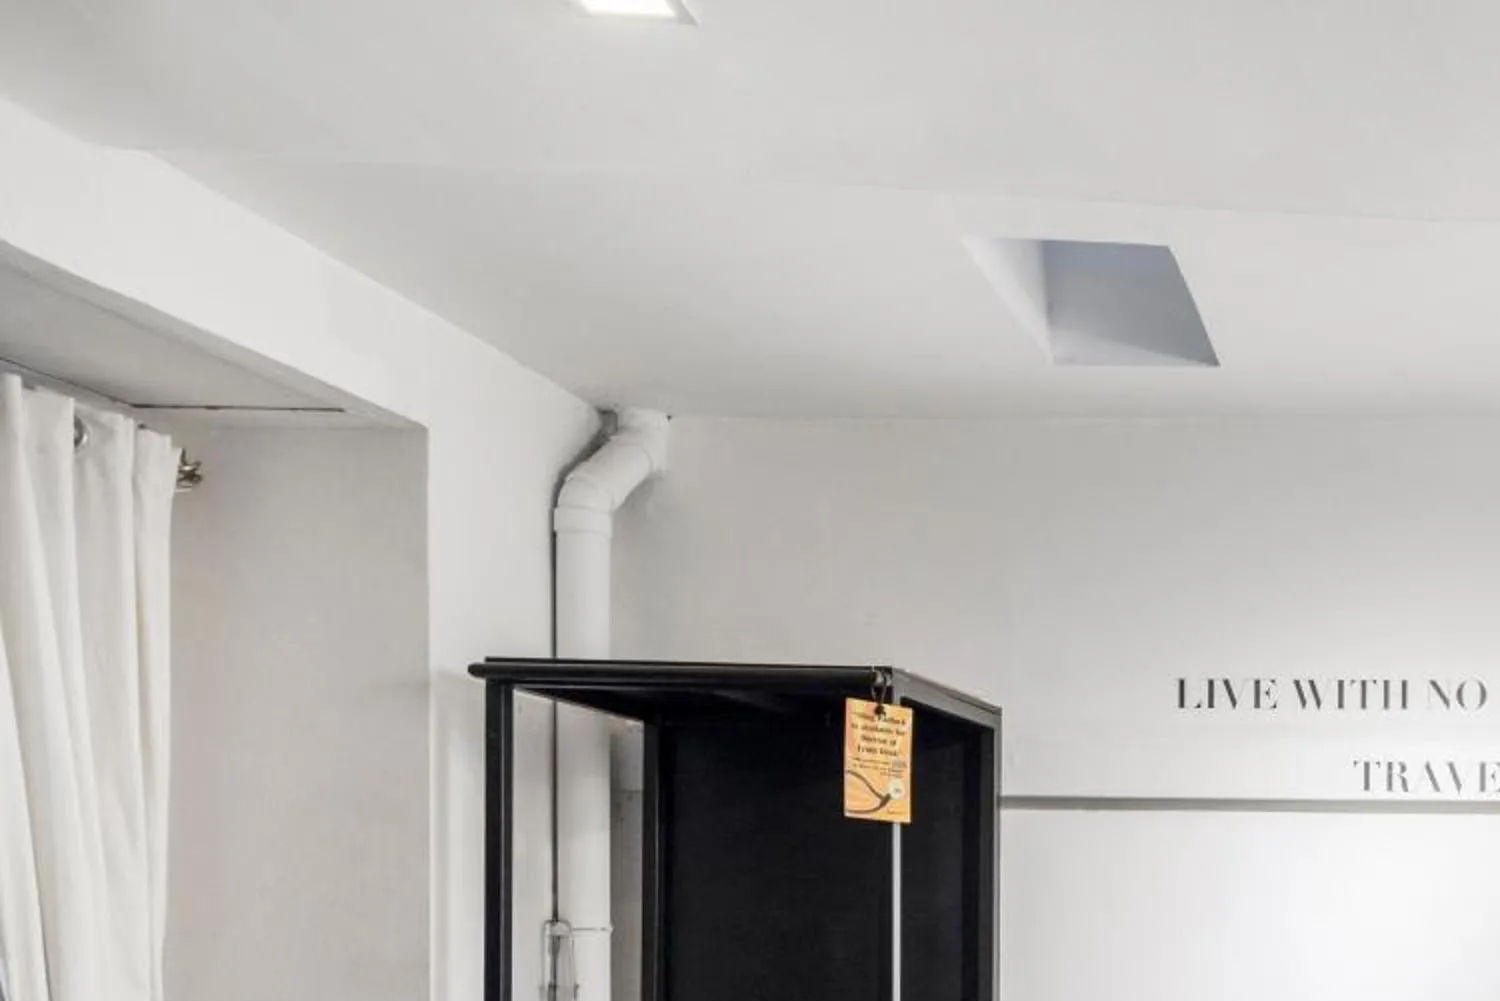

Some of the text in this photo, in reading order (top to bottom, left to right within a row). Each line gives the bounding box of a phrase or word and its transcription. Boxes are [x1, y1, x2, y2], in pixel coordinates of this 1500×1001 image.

[1176, 677, 1279, 711] LIVE
[1292, 678, 1409, 712] WITH
[1428, 678, 1488, 712] NO
